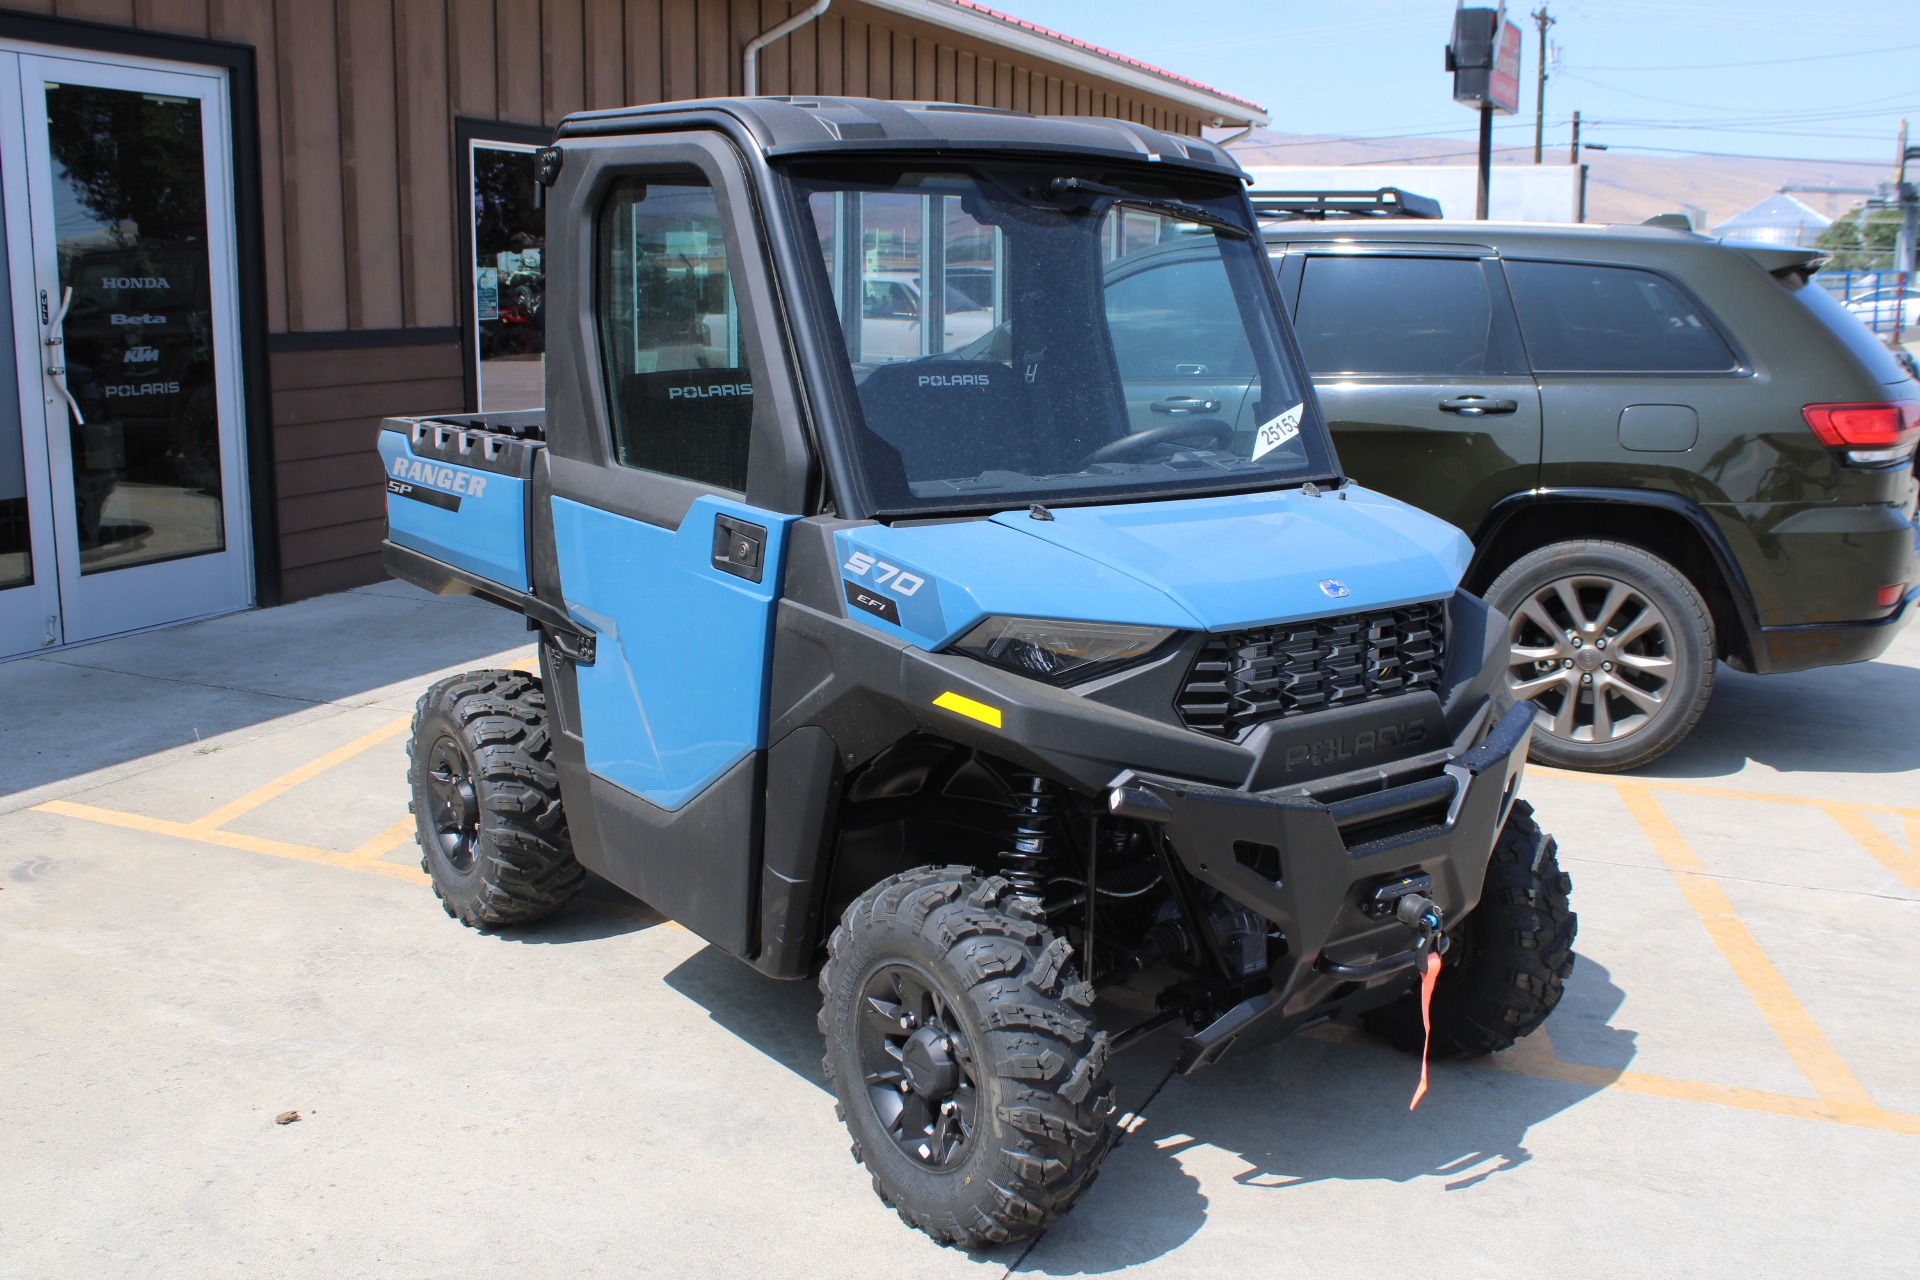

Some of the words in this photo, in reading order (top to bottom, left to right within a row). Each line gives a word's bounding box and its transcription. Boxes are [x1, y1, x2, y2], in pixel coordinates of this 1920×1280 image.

[102, 277, 171, 289] HONDA
[110, 313, 167, 325] Beta
[123, 346, 160, 363] KTM
[917, 374, 990, 387] POLARIS
[105, 381, 180, 398] POLARIS
[668, 383, 754, 399] POLARIS
[1260, 414, 1300, 446] 25153
[392, 456, 488, 498] RANGER
[387, 480, 413, 494] SP
[856, 594, 886, 611] EFI
[1284, 717, 1427, 773] POLARIS
